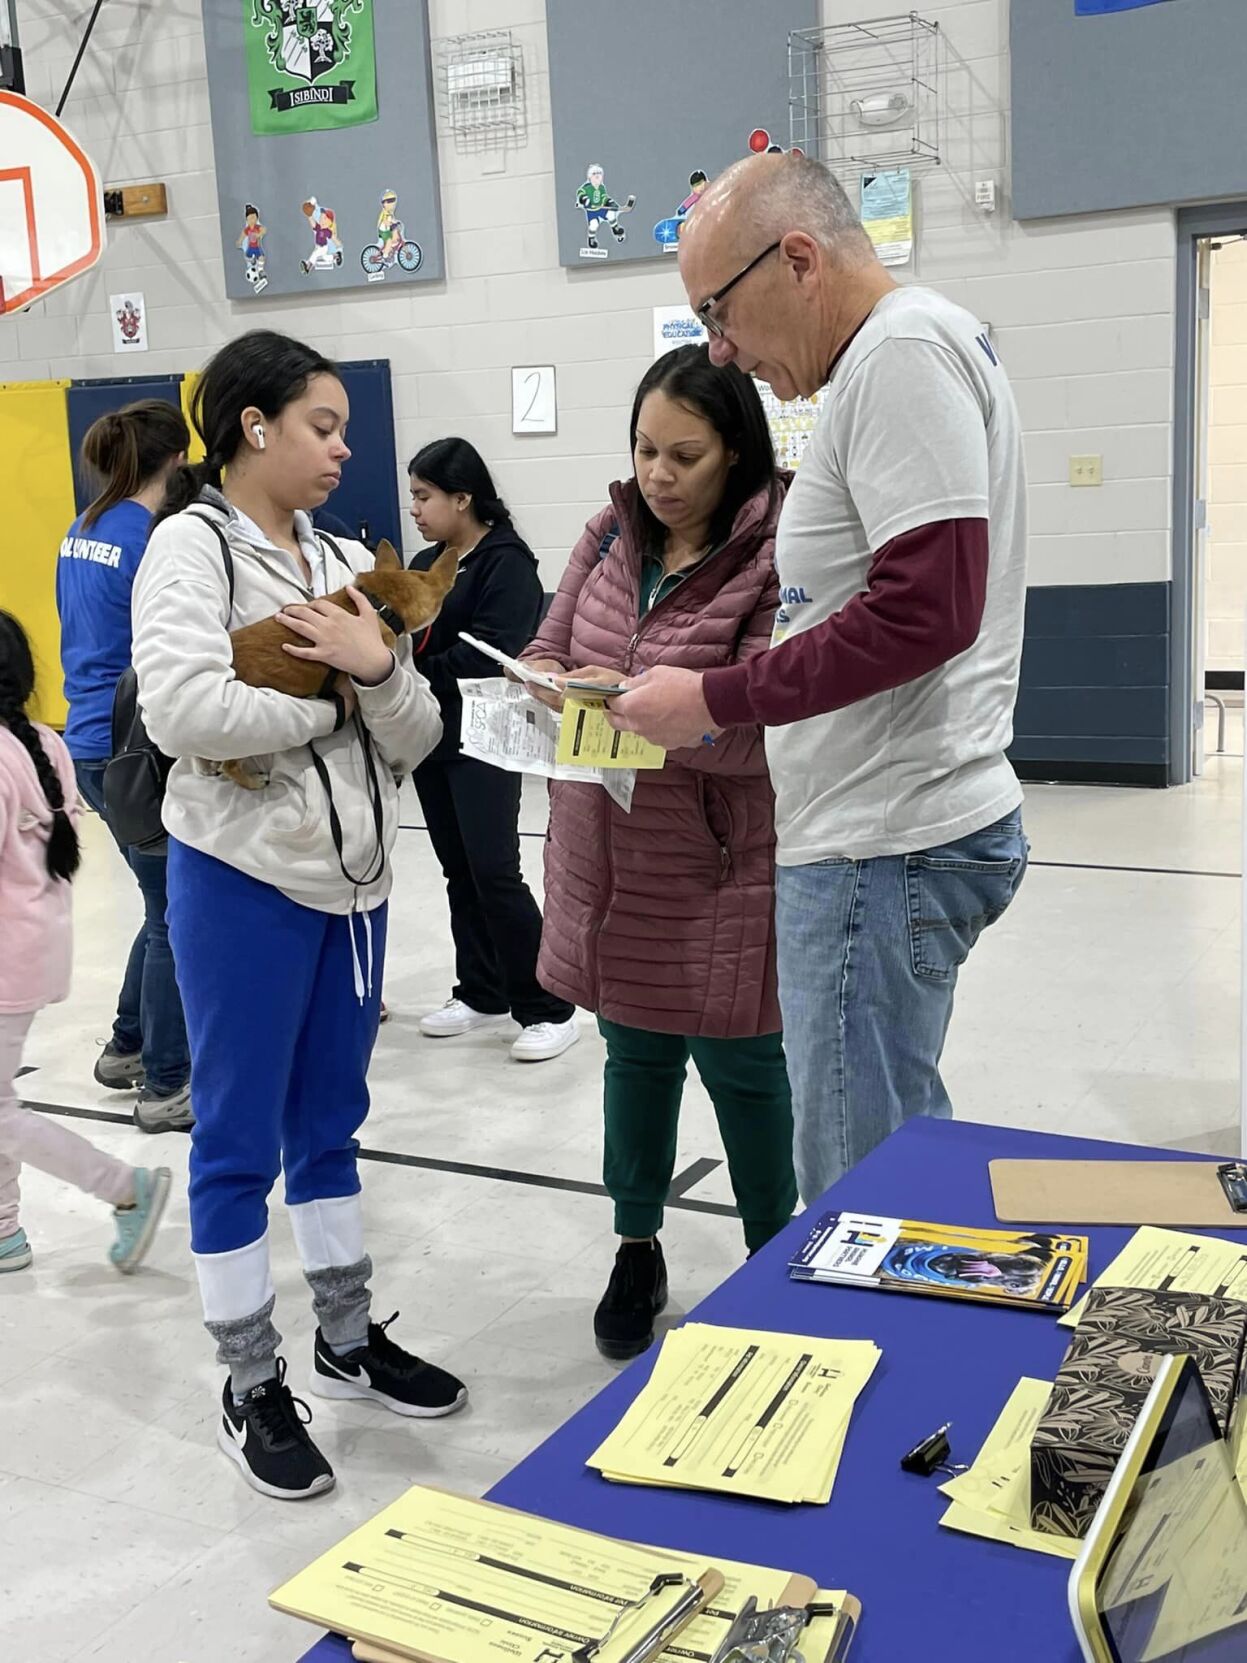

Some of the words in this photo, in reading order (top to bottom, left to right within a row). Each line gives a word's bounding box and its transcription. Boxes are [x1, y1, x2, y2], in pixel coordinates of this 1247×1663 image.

[289, 87, 334, 107] ISIBINDI
[521, 371, 545, 422] 2
[60, 536, 122, 568] OLUNTEER
[705, 1608, 720, 1616] Pet
[518, 1618, 564, 1637] Information
[564, 1632, 591, 1645] Owner
[667, 1647, 695, 1657] Owner
